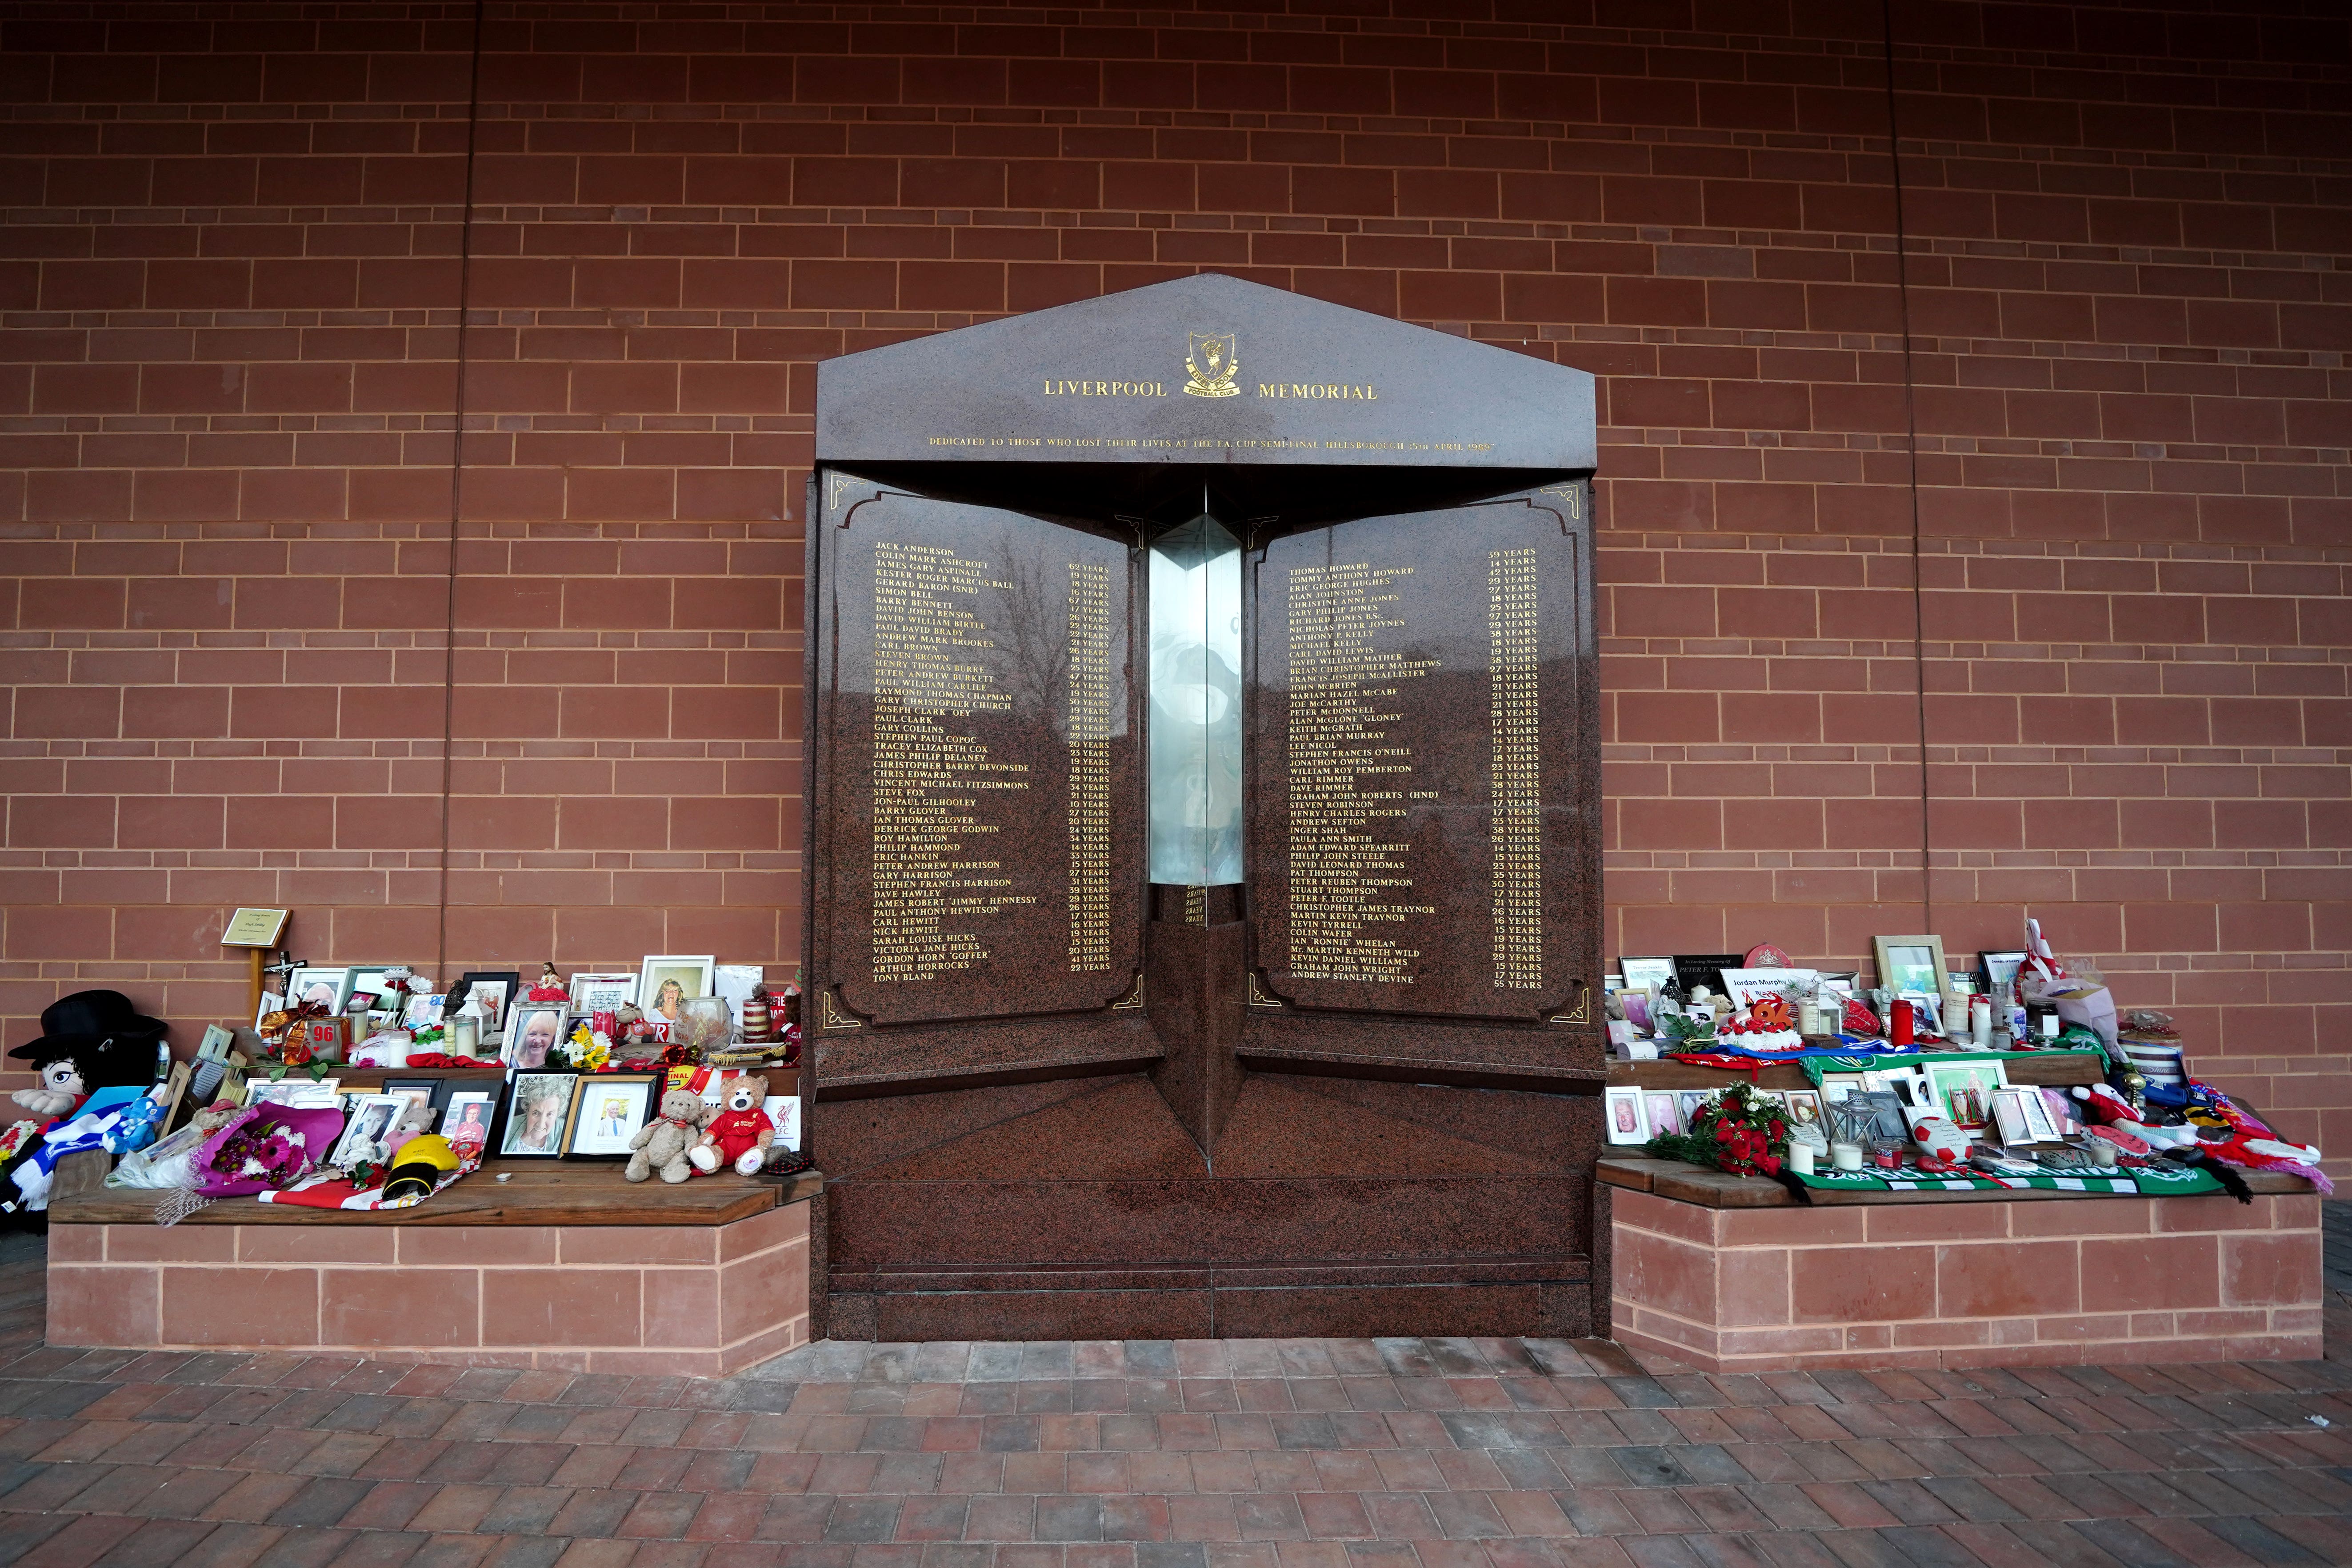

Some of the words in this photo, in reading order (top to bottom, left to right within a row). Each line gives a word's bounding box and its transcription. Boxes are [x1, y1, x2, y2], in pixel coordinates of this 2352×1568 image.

[1044, 380, 1168, 397] LIVERPOOL
[1188, 388, 1218, 397] FOOTBALL
[1259, 384, 1378, 400] MEMORIAL
[991, 438, 1003, 446] TO
[1008, 438, 1041, 446] THOSE
[1047, 438, 1072, 446] WHO
[1326, 441, 1404, 450] HILLSBOROUGH
[876, 541, 898, 550] JACK
[904, 544, 952, 556] ANDERSON
[1291, 575, 1320, 583] TOMMY
[1326, 571, 1367, 580] ANTHONY
[1374, 568, 1413, 576] HOWARD
[1504, 566, 1536, 575] YEARS
[876, 587, 906, 596] SIMON
[911, 590, 932, 598] BELL
[876, 632, 916, 641] ANDREW
[921, 636, 947, 644] MARK
[952, 638, 993, 647] BROOKES
[1320, 656, 1359, 664] WILLIAM
[1364, 654, 1401, 662] MATHER
[903, 724, 943, 732] COLLINS
[873, 760, 940, 769] CHRISTOPHER
[909, 935, 942, 943] LOUISE
[1346, 948, 1389, 956] KENNETH
[873, 964, 912, 972] ARTHUR
[917, 961, 969, 970] HORROCKS
[872, 974, 898, 982] TONY
[903, 972, 933, 980] BLAND
[1508, 980, 1541, 988] YEARS
[429, 995, 446, 1006] 80
[314, 1026, 333, 1042] 96
